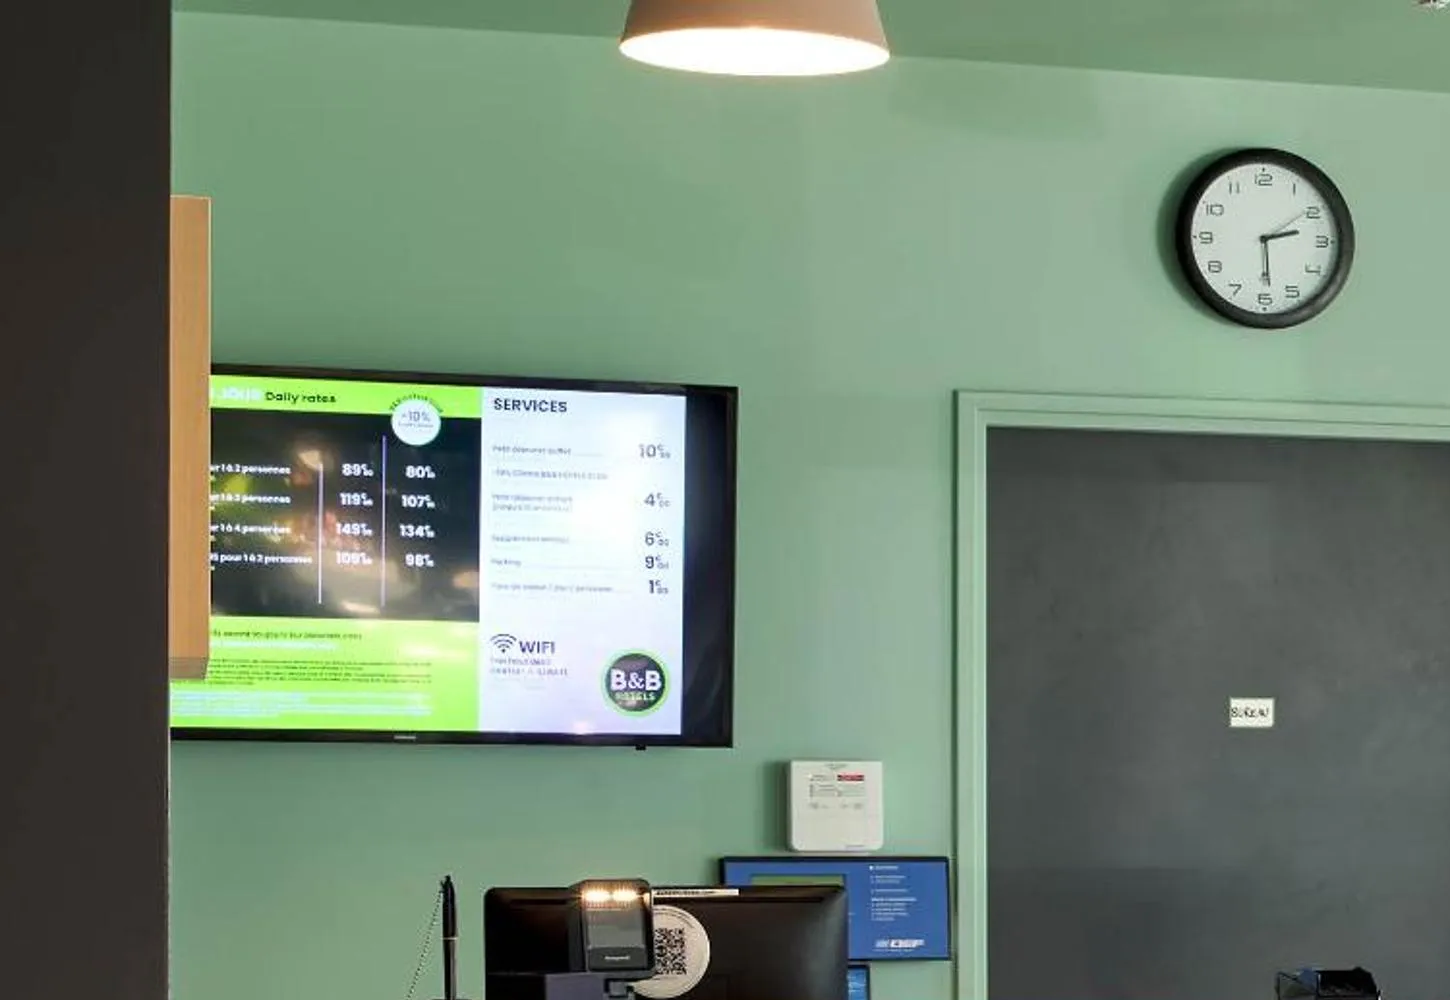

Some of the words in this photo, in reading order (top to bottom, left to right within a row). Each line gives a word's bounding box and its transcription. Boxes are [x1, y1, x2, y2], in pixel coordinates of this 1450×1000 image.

[1254, 173, 1273, 187] 12
[1228, 181, 1241, 195] 11
[1205, 204, 1225, 217] 10
[1305, 206, 1321, 220] 2
[1198, 231, 1213, 245] 9
[1315, 235, 1330, 249] 3
[1207, 260, 1223, 274] 8
[1228, 283, 1243, 297] 7
[1284, 285, 1300, 299] 5
[1257, 293, 1273, 306] 6
[265, 391, 299, 405] Daily
[301, 393, 337, 404] rates
[493, 397, 568, 413] SERVICES
[518, 640, 556, 655] WIFI
[610, 667, 663, 691] B&B
